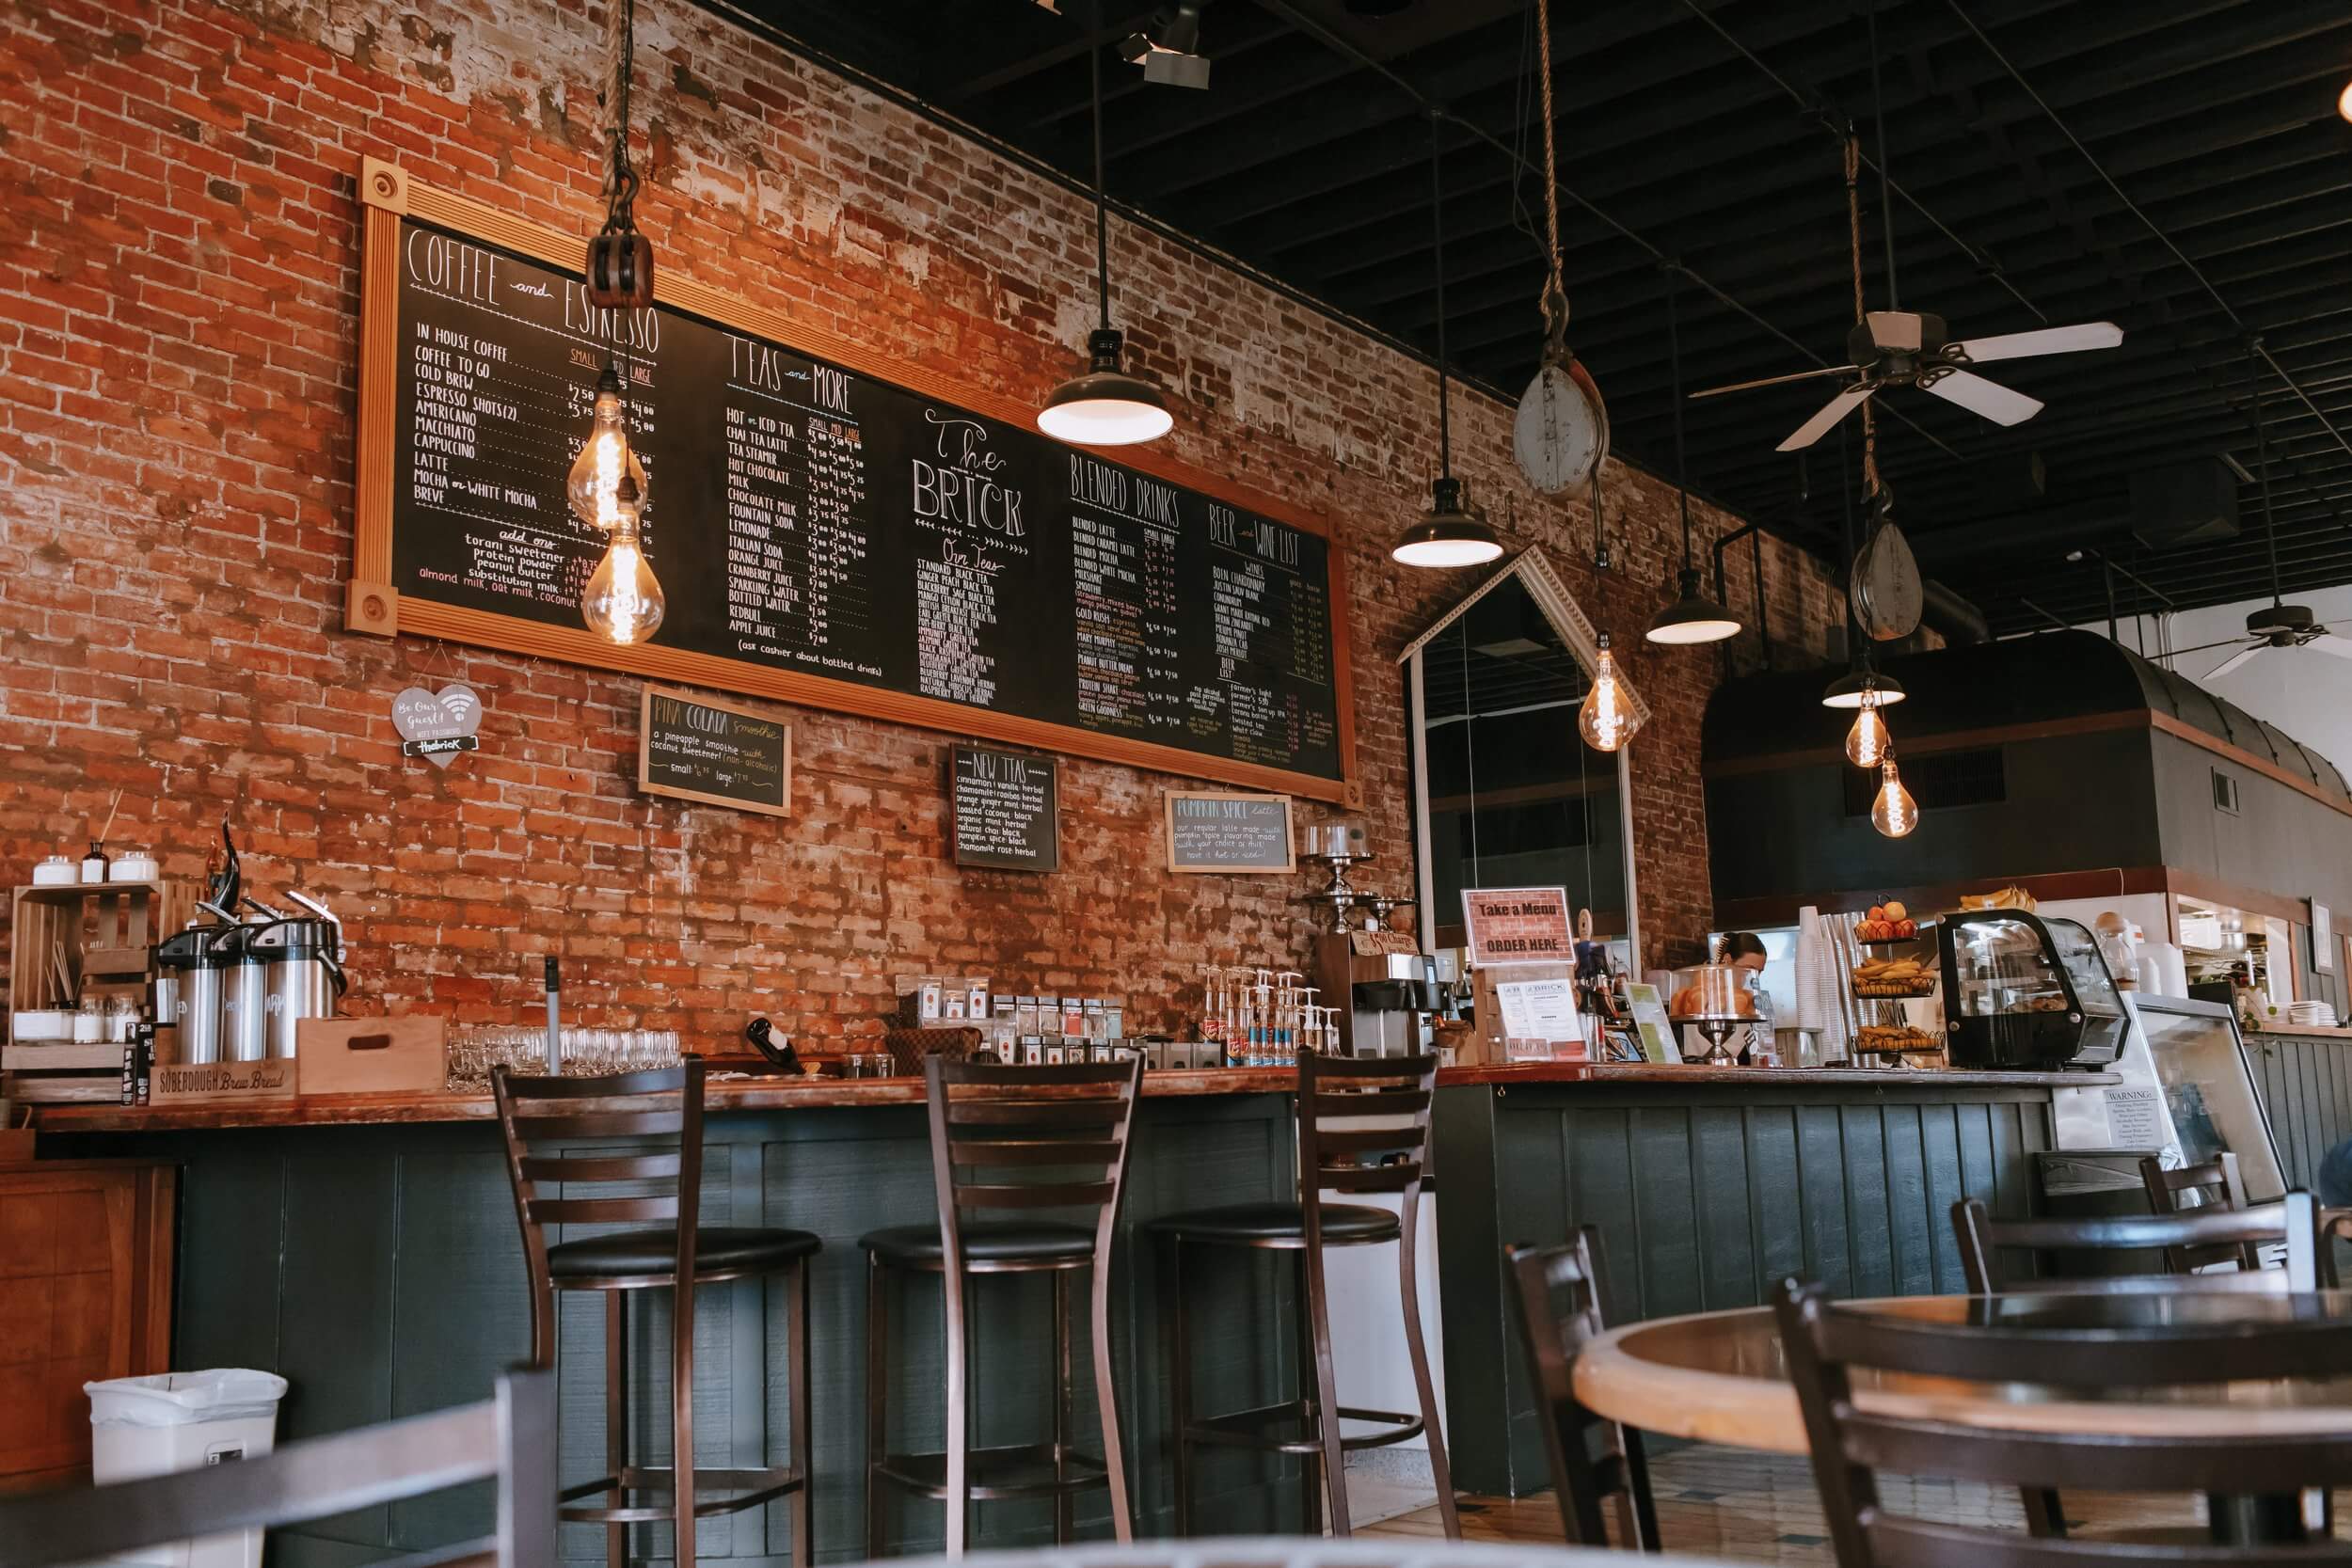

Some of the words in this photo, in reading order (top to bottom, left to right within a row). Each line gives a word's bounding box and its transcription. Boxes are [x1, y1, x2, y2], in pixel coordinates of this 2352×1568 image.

[408, 230, 504, 305] COFFEE
[510, 282, 555, 298] and
[417, 322, 429, 340] IN
[435, 328, 469, 351] HOUSE
[473, 339, 508, 362] COFFEE
[415, 344, 452, 366] COFFEE
[458, 356, 472, 373] TO
[476, 361, 490, 378] GO
[570, 349, 597, 368] SMALL
[630, 366, 651, 384] LARGE
[415, 364, 440, 382] COLD
[446, 370, 473, 390] BREW
[723, 332, 781, 391] TEAS
[785, 371, 811, 381] and
[814, 364, 853, 415] MORE
[415, 400, 476, 426] AMERICANO
[416, 383, 467, 407] ESPRESSO
[472, 396, 517, 421] SHOTS(2)
[415, 416, 475, 443] MACCHIATO
[726, 407, 745, 424] HOT
[758, 417, 775, 433] ICED
[779, 421, 795, 439] TEA
[414, 433, 475, 459] CAPPUCCINO
[726, 426, 746, 440] CHAI
[750, 431, 766, 448] TEA
[767, 434, 787, 452] LATTE
[926, 408, 1007, 470] The
[414, 451, 449, 471] LATTE
[727, 441, 743, 456] TEA
[745, 446, 777, 466] STEAMER
[728, 457, 744, 472] HOT
[747, 463, 790, 485] CHOCOLATE
[728, 473, 749, 489] MILK
[414, 468, 448, 489] MOCHA
[468, 481, 501, 499] WHITE
[504, 489, 537, 509] MOCHA
[414, 484, 444, 503] BREVE
[913, 459, 1025, 536] BRICK
[1071, 453, 1126, 511] BLENDED
[1136, 478, 1180, 528] DRINKS
[728, 488, 773, 511] CHOCOLATE
[778, 500, 797, 517] MILK
[729, 502, 771, 525] FOUNTAIN
[774, 515, 794, 531] SODA
[1073, 515, 1097, 532] BLENDED
[1099, 524, 1116, 538] LATTE
[499, 530, 527, 542] add
[729, 518, 771, 540] LEMONADE
[1209, 503, 1236, 547] BEER
[1254, 519, 1275, 560] WINE
[1279, 528, 1299, 566] LIST
[465, 533, 502, 550] torani
[729, 535, 761, 553] ITALIAN
[763, 543, 784, 559] SODA
[944, 538, 968, 565] Our
[473, 547, 515, 562] protein
[477, 559, 514, 574] peanut
[728, 549, 759, 566] ORANGE
[763, 557, 783, 571] JUICE
[1073, 544, 1097, 560] BLENDED
[1099, 550, 1119, 565] MOCHA
[469, 568, 532, 589] substitution
[728, 562, 771, 581] CRANBERRY
[773, 574, 793, 587] JUICE
[917, 558, 951, 575] STANDARD
[955, 568, 973, 581] BLACK
[977, 574, 988, 585] TEA
[942, 574, 960, 588] PEACH
[963, 580, 979, 593] BLACK
[420, 568, 458, 584] almond
[491, 581, 508, 594] oat
[540, 592, 577, 608] coconut
[728, 576, 770, 595] SPARKLING
[772, 585, 800, 603] WATER
[728, 589, 762, 607] BOTTLED
[765, 596, 791, 613] WATER
[729, 605, 761, 623] REDBULL
[1075, 608, 1092, 620] GOLD
[1093, 610, 1110, 625] RUSH
[728, 620, 752, 634] APPLE
[755, 625, 776, 639] JUICE
[1077, 632, 1092, 644] MARY
[760, 644, 792, 657] cashier
[796, 651, 820, 663] about
[822, 656, 854, 671] bottled
[1221, 657, 1234, 671] BEER
[1219, 668, 1232, 678] LIST
[415, 701, 437, 712] Our
[686, 705, 728, 736] COLADA
[651, 740, 678, 753] coconut
[653, 730, 660, 738] a
[664, 732, 700, 748] pineapple
[706, 739, 739, 756] smoothie
[973, 752, 996, 780] NEW
[1001, 756, 1026, 784] TEAS
[957, 775, 992, 787] cinnamon
[1023, 784, 1044, 795] herbal
[957, 796, 978, 806] orange
[981, 799, 1001, 809] ginger
[1023, 802, 1042, 813] herbal
[985, 808, 1010, 819] coconut
[1014, 812, 1033, 821] black
[1177, 800, 1219, 817] PUMPKIN
[1223, 800, 1249, 819] SPICE
[1002, 828, 1021, 837] black
[997, 845, 1012, 855] rose
[1015, 847, 1036, 857] herbal
[1479, 903, 1509, 916] Take
[1512, 906, 1520, 915] a
[1522, 902, 1557, 915] Menu
[1486, 939, 1526, 952] ORDER
[1529, 938, 1560, 951] HERE
[219, 1072, 249, 1090] Brew
[249, 1069, 285, 1089] Bread
